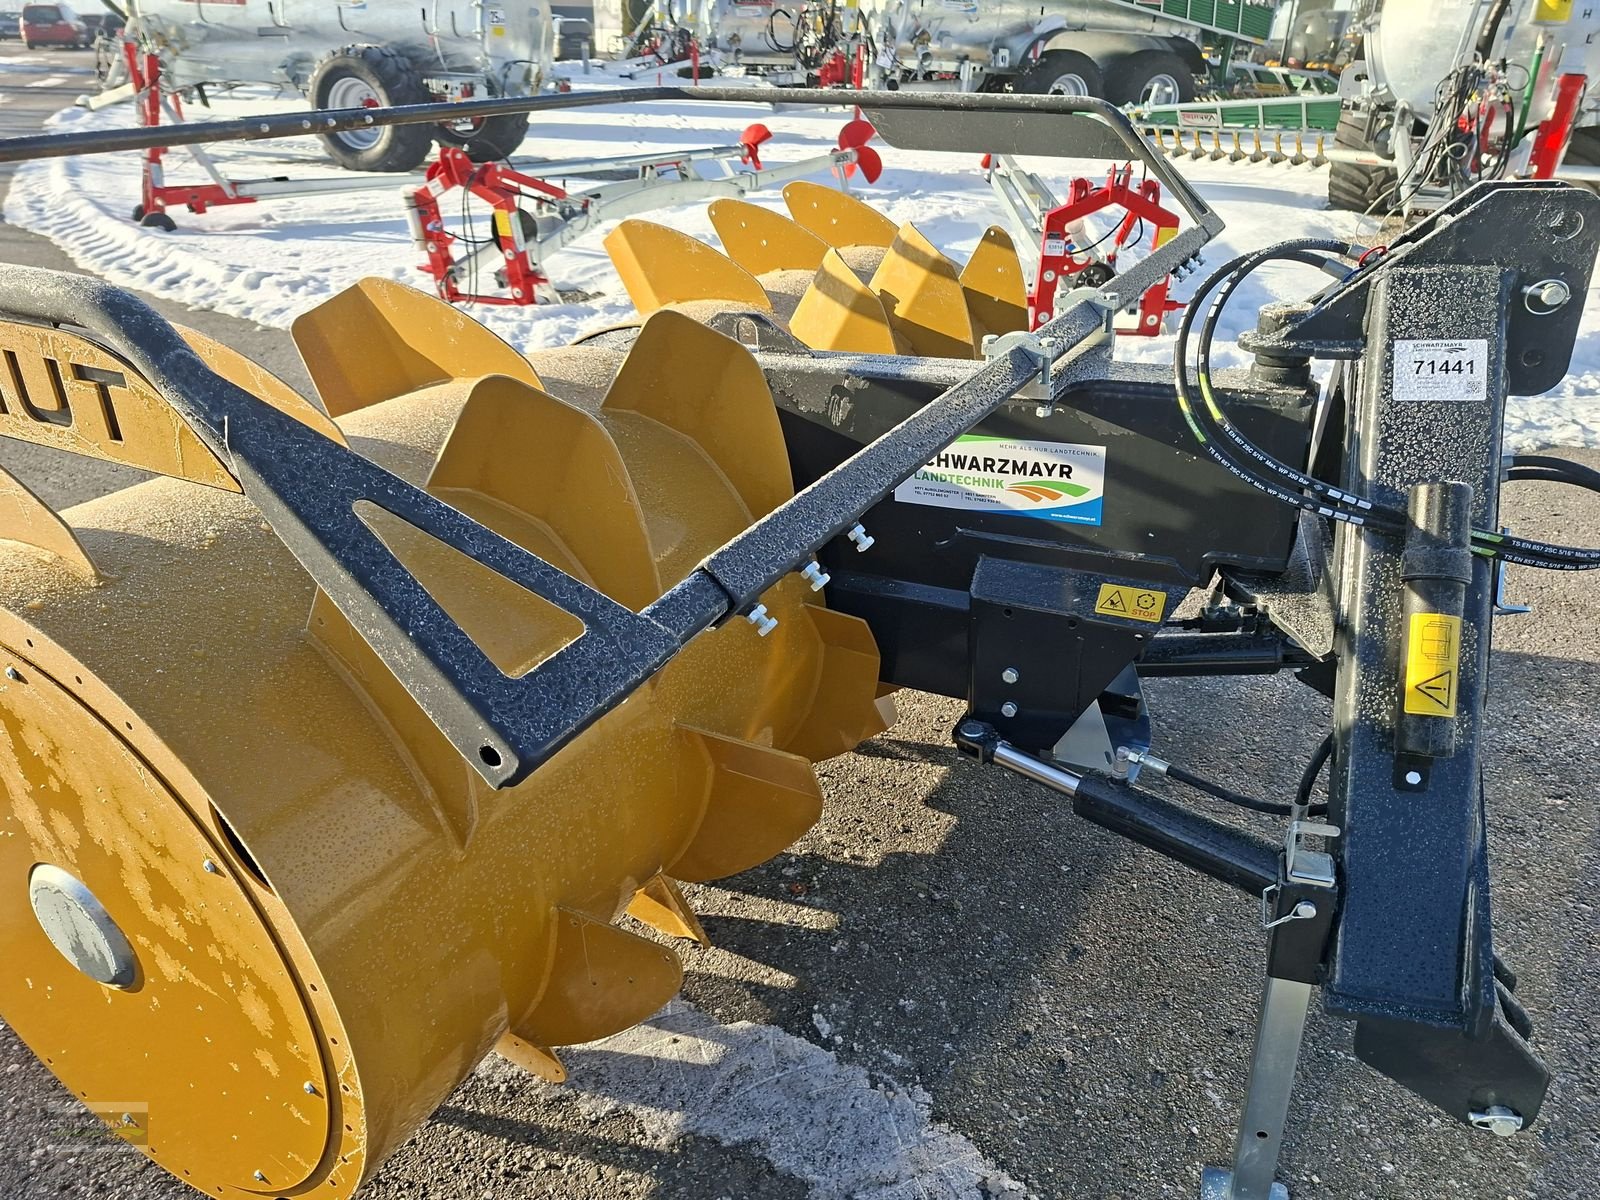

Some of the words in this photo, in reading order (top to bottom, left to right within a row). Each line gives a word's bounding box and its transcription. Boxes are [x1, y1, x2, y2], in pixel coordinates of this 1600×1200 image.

[1582, 8, 1593, 19] H
[1413, 359, 1475, 375] 71441
[0, 349, 127, 442] UT
[926, 452, 1073, 480] HWARZMAYR
[1265, 459, 1278, 471] Max.
[1278, 466, 1289, 475] WP
[1288, 471, 1299, 481] 350
[1298, 476, 1310, 486] Bar
[914, 470, 1005, 489] LANDTECHNIK
[1253, 480, 1267, 492] Max.
[1267, 487, 1278, 497] WP
[1277, 492, 1289, 501] 350
[1288, 496, 1300, 505] Bar
[1544, 546, 1558, 554] 2SC
[1513, 555, 1523, 563] EN
[1535, 560, 1548, 568] 2SC
[1131, 608, 1157, 618] STOP
